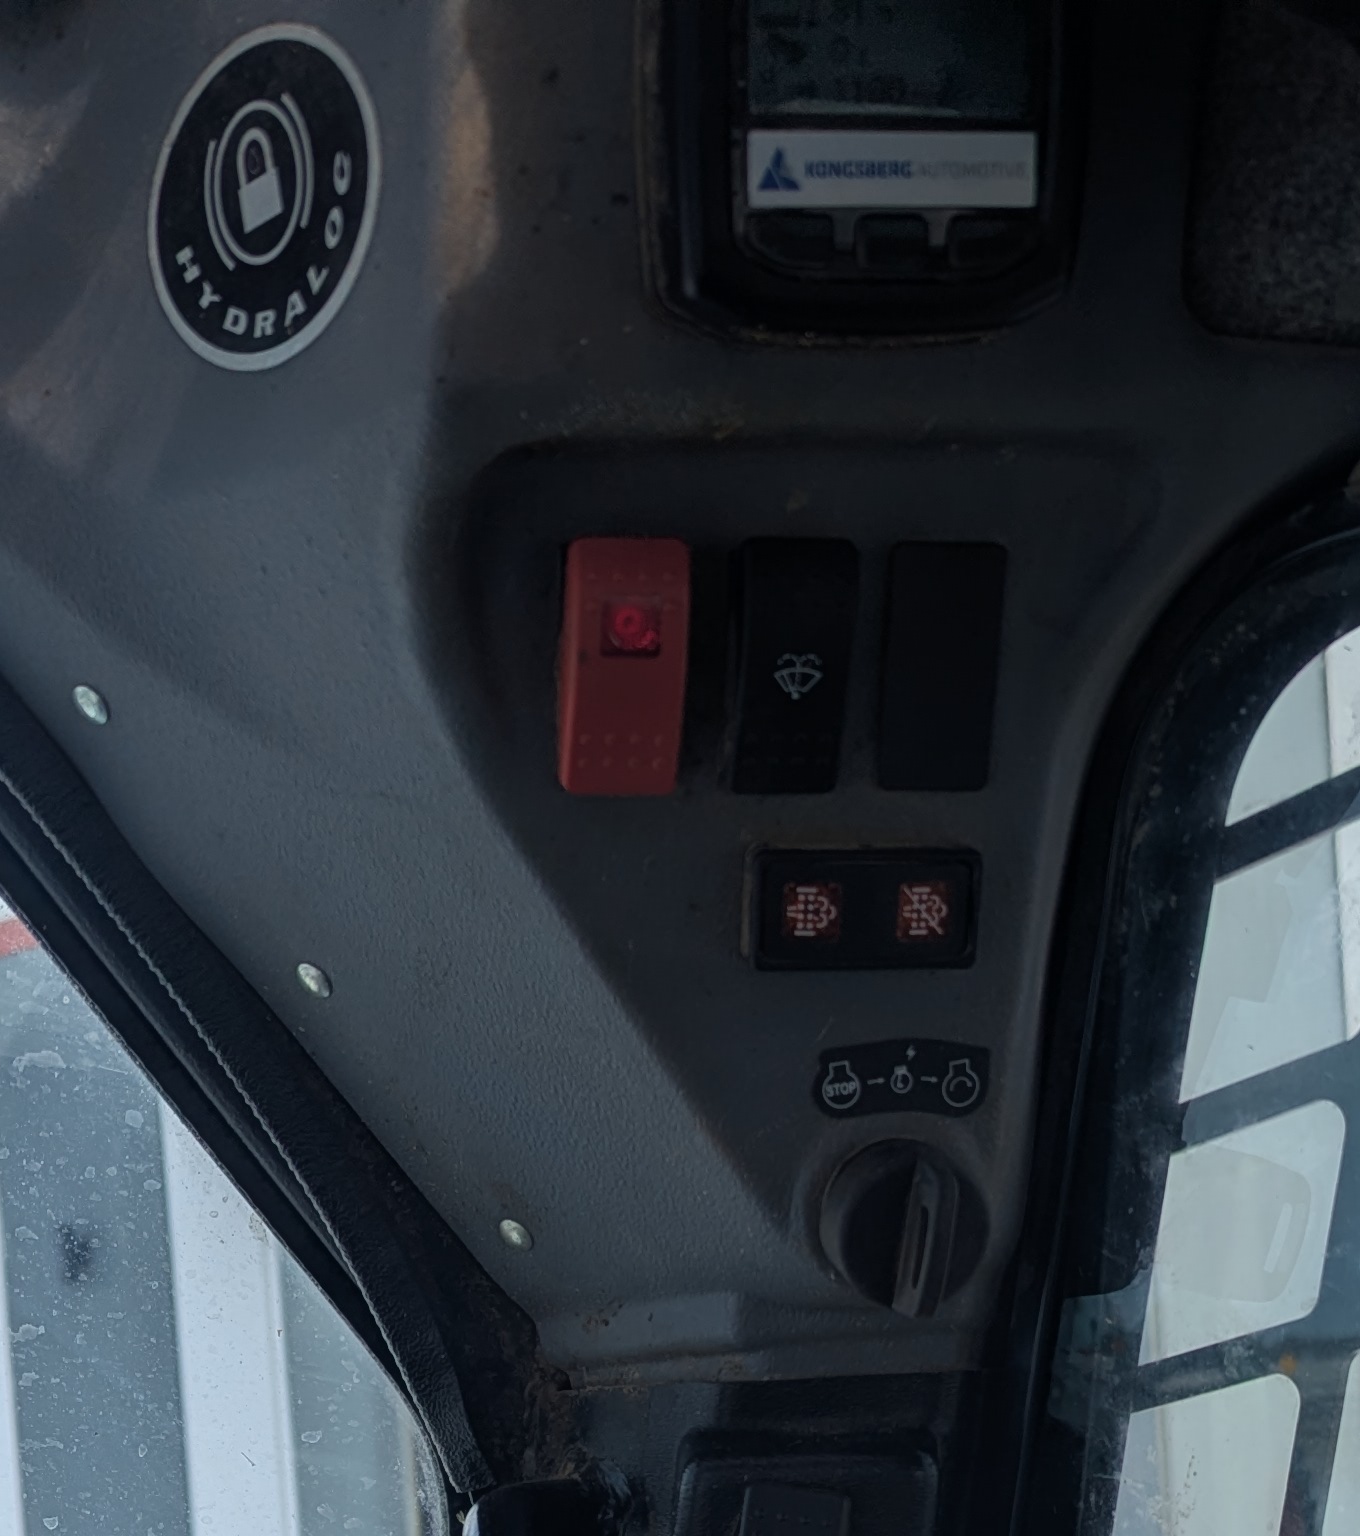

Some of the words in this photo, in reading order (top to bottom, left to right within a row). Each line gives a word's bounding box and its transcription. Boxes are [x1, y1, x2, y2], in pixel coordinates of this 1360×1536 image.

[803, 159, 913, 179] KONGSBERG
[176, 150, 353, 339] HYDRALOC
[825, 1081, 857, 1098] STOP
